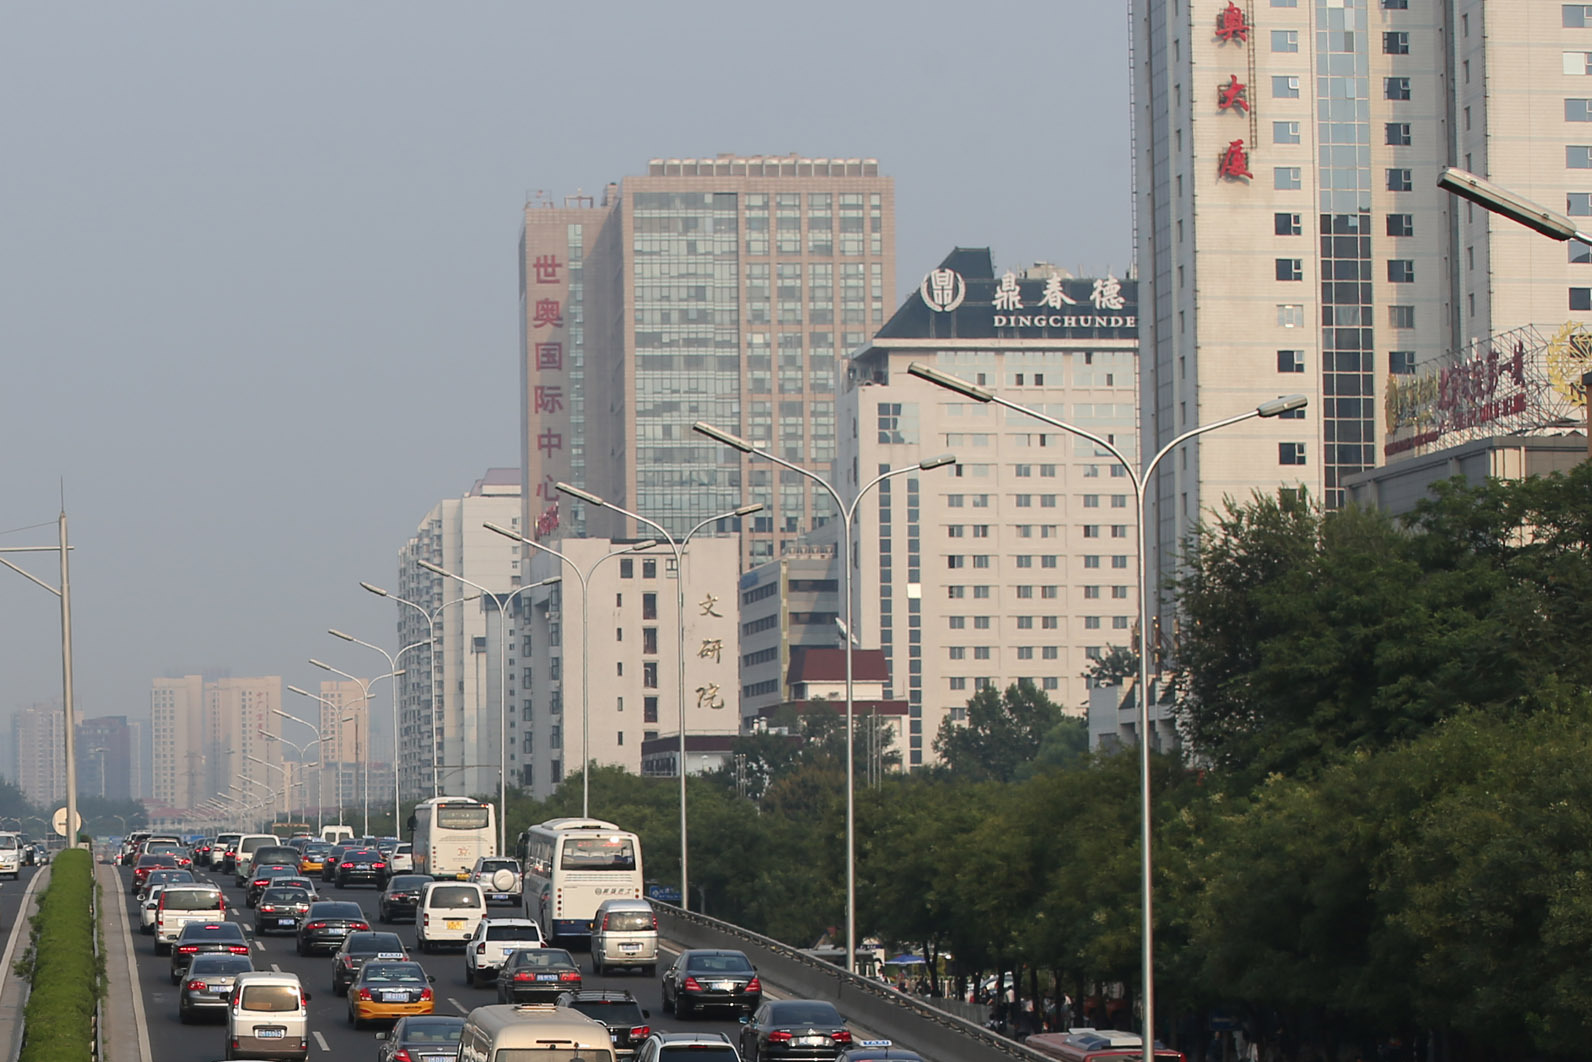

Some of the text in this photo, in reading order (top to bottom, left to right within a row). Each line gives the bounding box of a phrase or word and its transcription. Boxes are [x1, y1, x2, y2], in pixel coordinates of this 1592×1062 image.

[992, 270, 1126, 310] 鼎春德
[993, 315, 1136, 328] DINGCHUNDE
[533, 255, 563, 501] 世奥国际中心
[695, 594, 725, 709] 文研院
